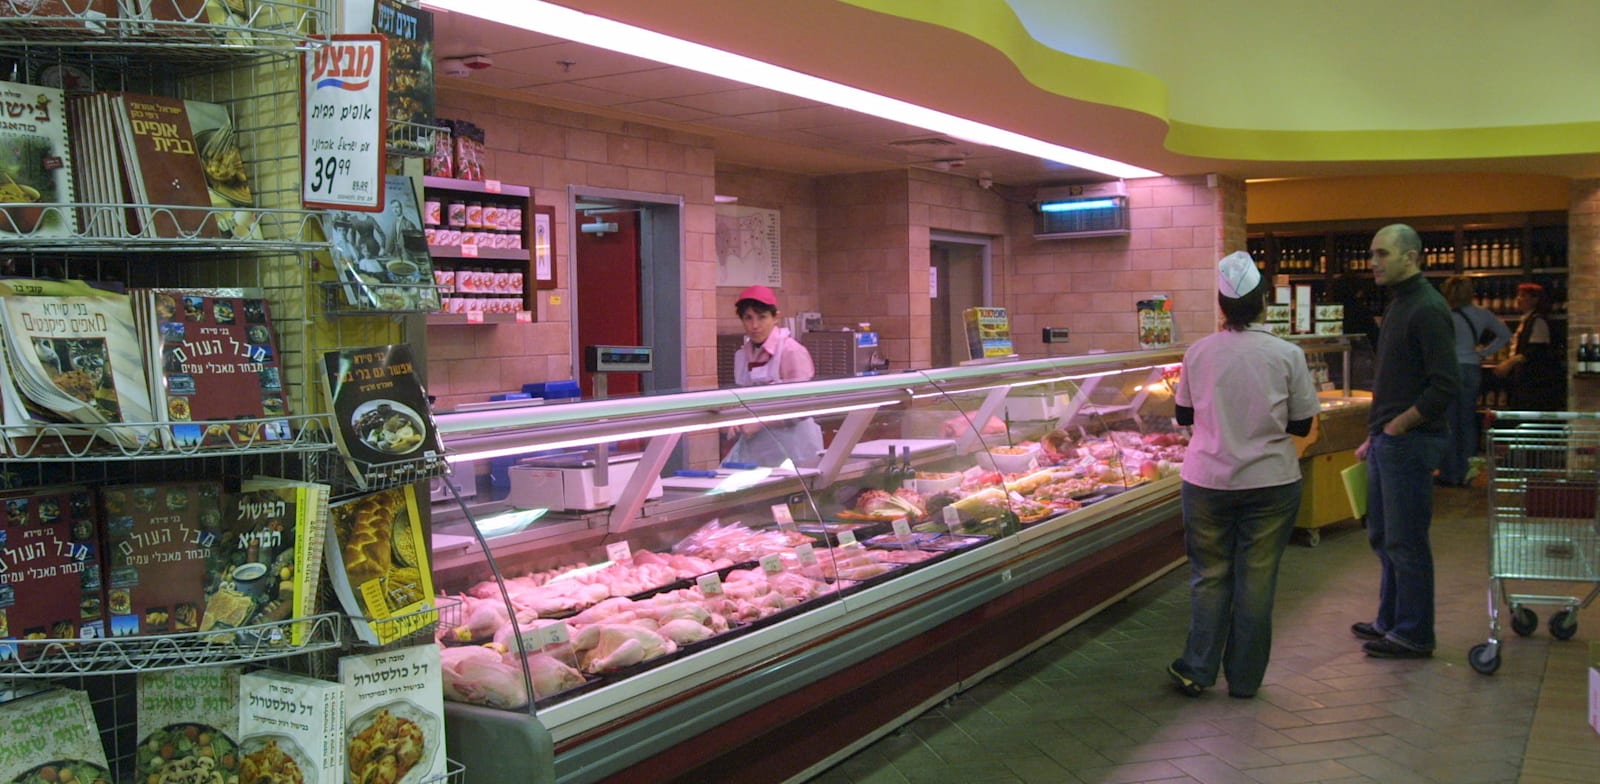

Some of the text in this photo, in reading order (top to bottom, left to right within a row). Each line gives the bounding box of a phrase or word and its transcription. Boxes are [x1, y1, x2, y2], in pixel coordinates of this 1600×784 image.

[312, 45, 374, 81] מבצע
[130, 110, 144, 118] כהן
[156, 104, 182, 114] ישראל
[312, 104, 372, 120] אופים בבית
[131, 120, 179, 138] אופים
[152, 137, 195, 155] בבית
[311, 136, 371, 152] עם ישראל אהרוני
[311, 156, 351, 194] 39 99
[73, 303, 88, 316] בני
[21, 312, 107, 336] מאפים פיקנטים
[219, 327, 230, 335] בני
[173, 336, 266, 363] מכל העולם
[374, 352, 386, 362] בני
[181, 362, 264, 374] מבחר מאכלי עמים
[334, 362, 413, 382] אפשר גם בלי בר
[171, 515, 181, 523] בני
[237, 500, 285, 520] הבישול
[44, 527, 54, 536] בני
[118, 523, 215, 556] מכל העולם
[238, 530, 282, 549] הבריא
[53, 536, 88, 560] מכל
[126, 548, 212, 566] מבחר מאכלי עמים
[0, 562, 85, 585] מבחר מאכלי עמים
[388, 654, 405, 662] טובה
[174, 675, 229, 689] הסלטים
[353, 663, 428, 687] דל כולסטרול
[280, 686, 294, 694] טובה
[403, 683, 425, 691] בבישול
[249, 692, 313, 716] דל כולסטרול
[11, 702, 80, 734] הסלטים
